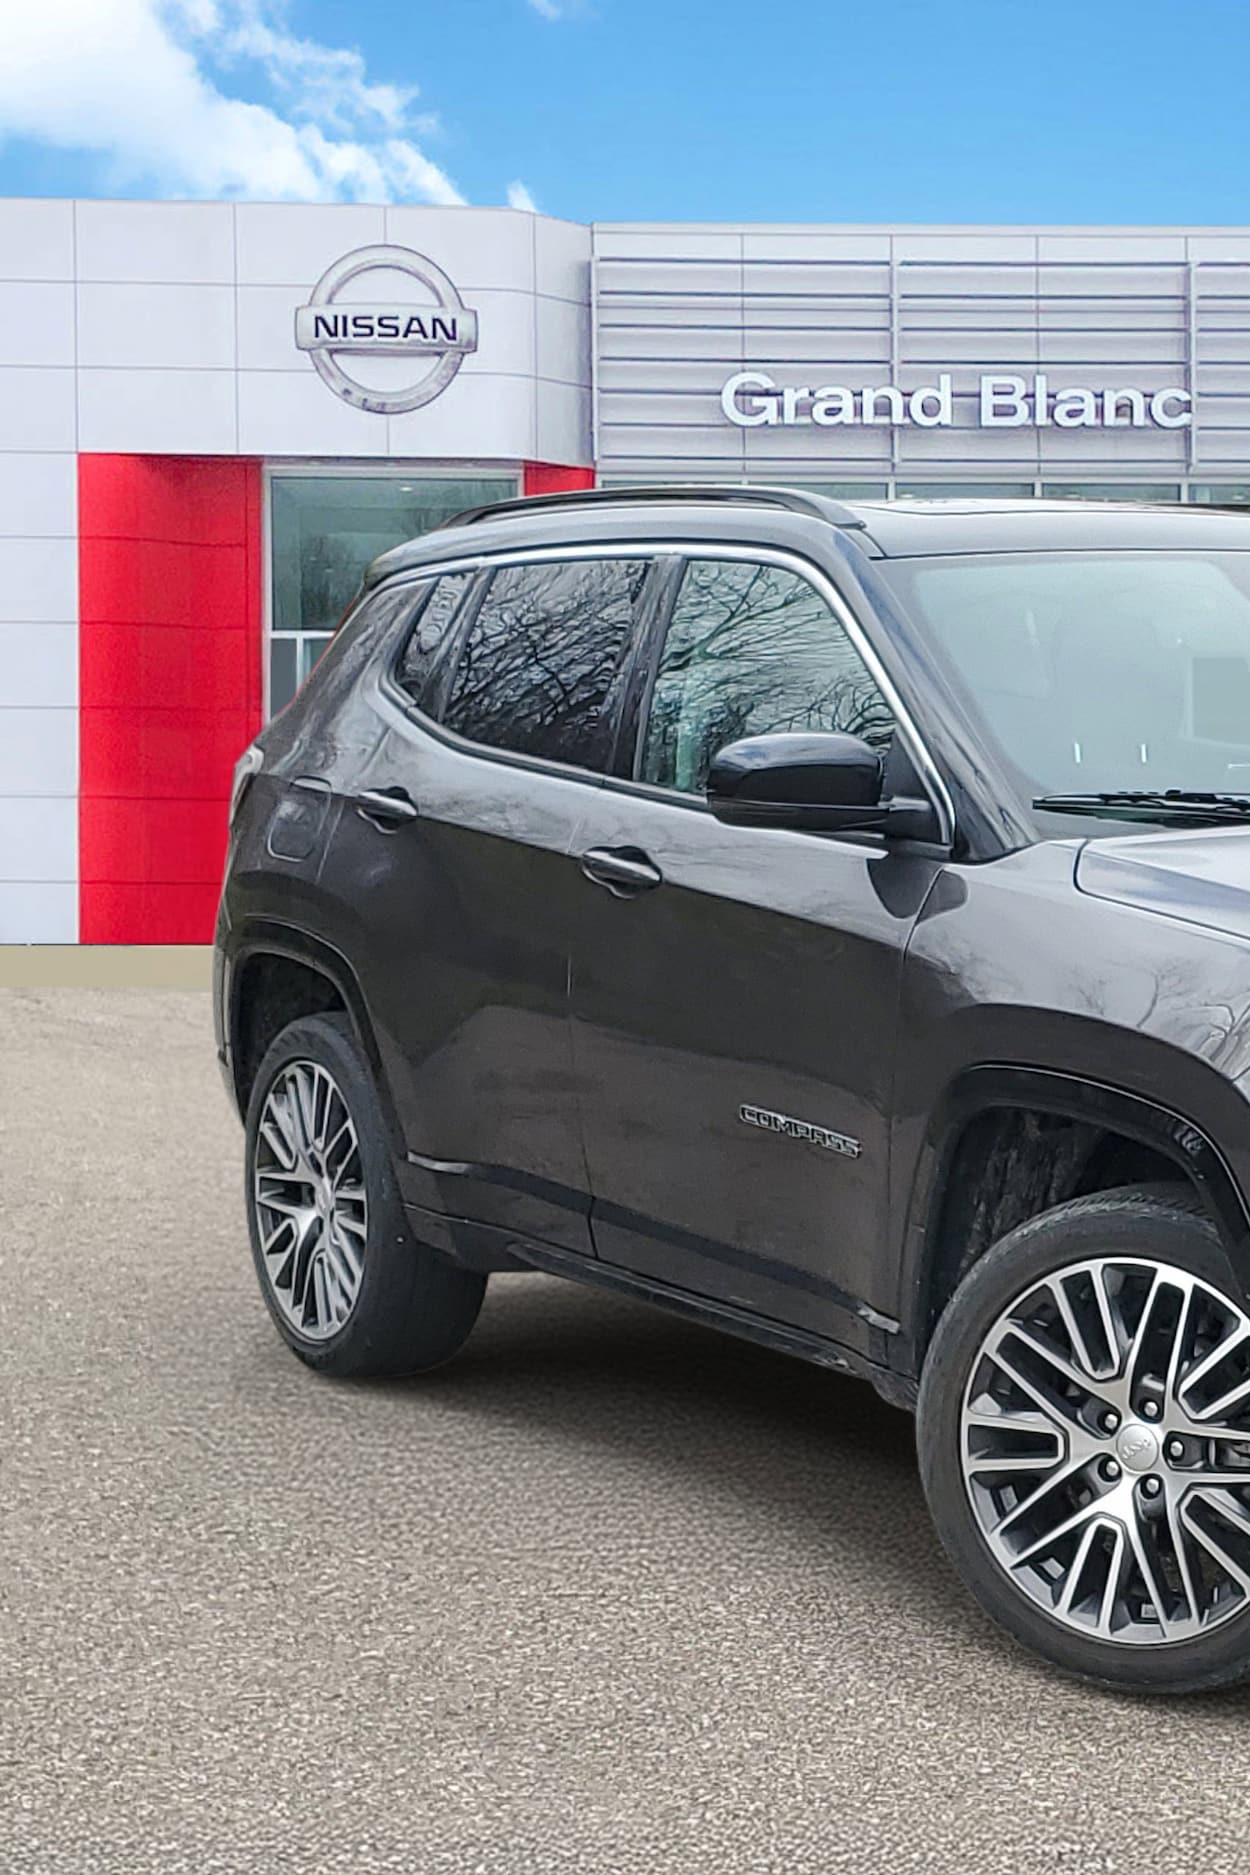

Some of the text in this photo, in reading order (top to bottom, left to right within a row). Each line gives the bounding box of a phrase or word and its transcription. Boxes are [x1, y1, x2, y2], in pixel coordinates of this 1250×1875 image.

[313, 315, 458, 341] NISSAN
[721, 372, 1192, 429] Grand Blanc
[740, 1104, 862, 1159] COMPASS
